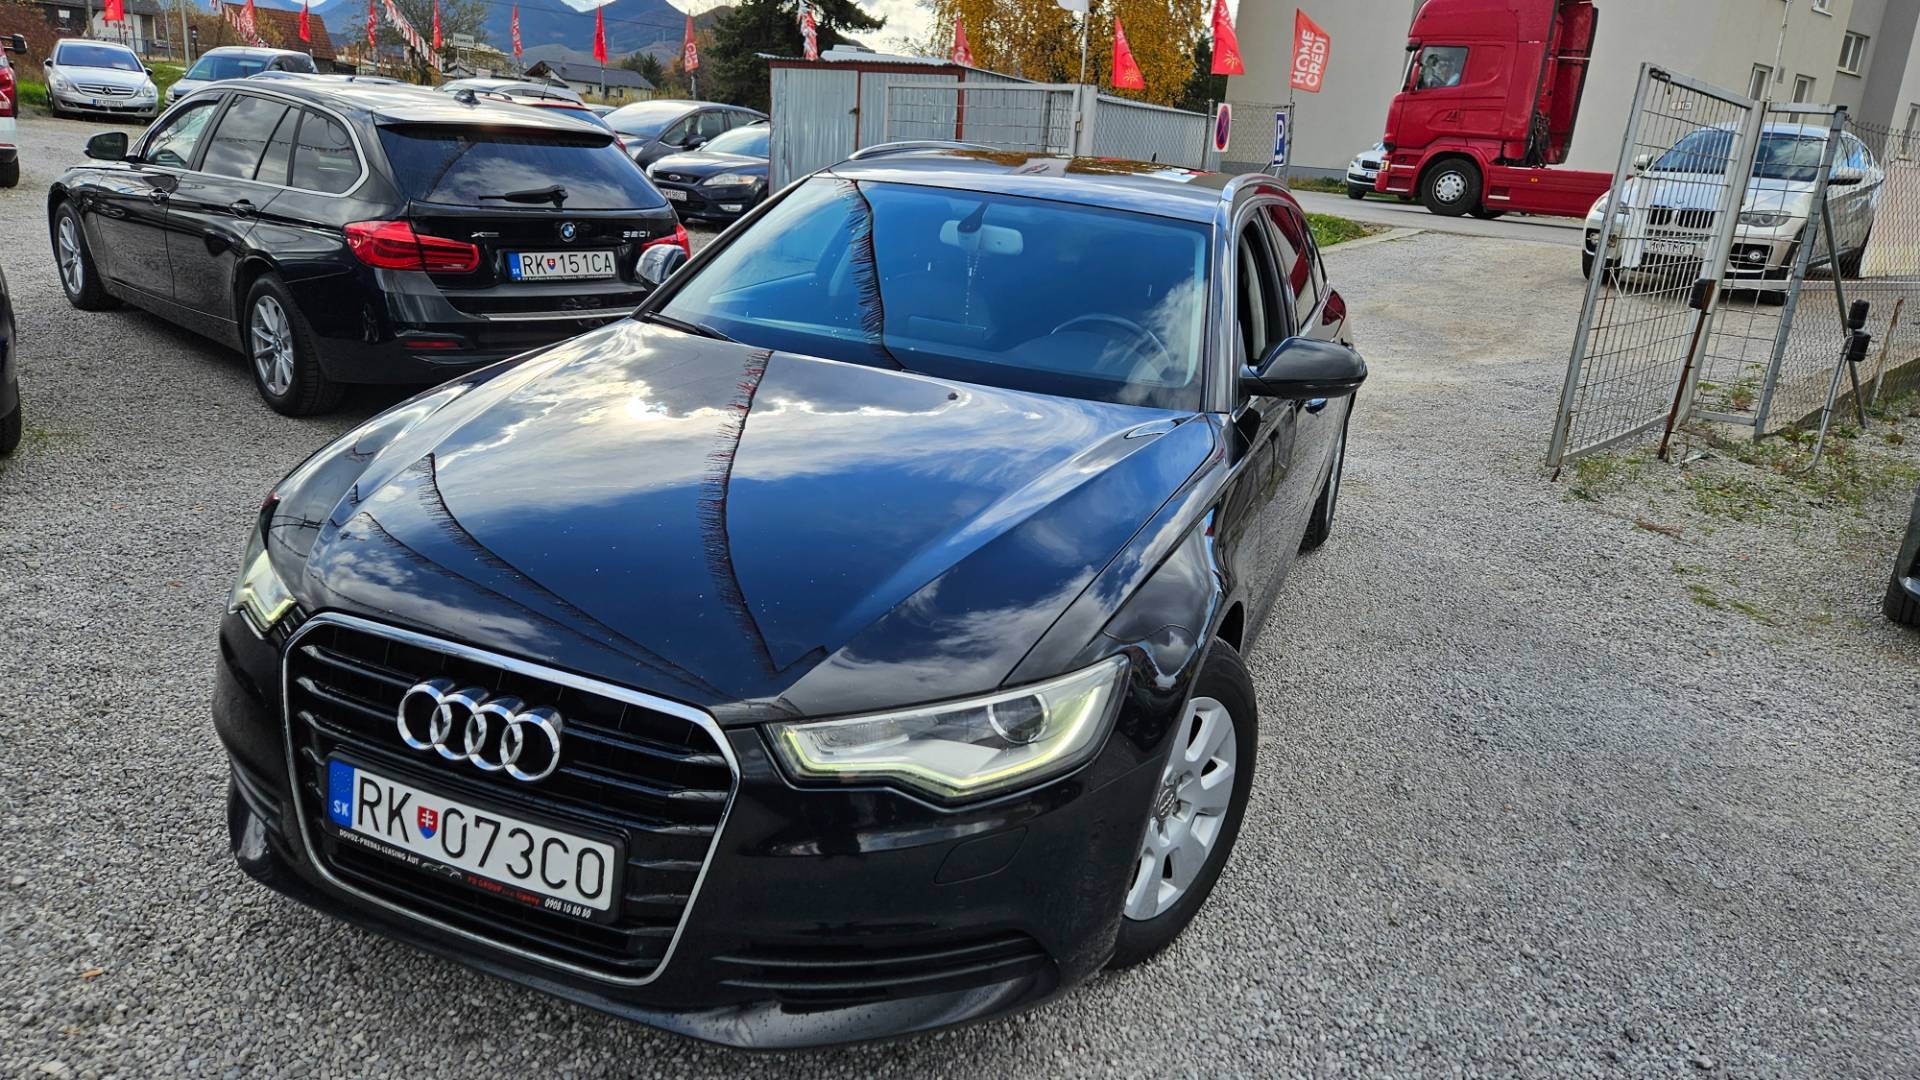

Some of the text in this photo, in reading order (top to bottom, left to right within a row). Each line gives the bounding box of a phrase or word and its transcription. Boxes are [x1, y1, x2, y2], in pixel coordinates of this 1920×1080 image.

[1293, 30, 1314, 83] HOME
[1306, 36, 1326, 86] CREDI
[1277, 120, 1284, 150] P
[522, 253, 613, 275] RK 151CA
[333, 800, 349, 817] SK
[357, 776, 605, 900] RK 073CO
[544, 898, 561, 910] 0908
[563, 903, 571, 913] 10
